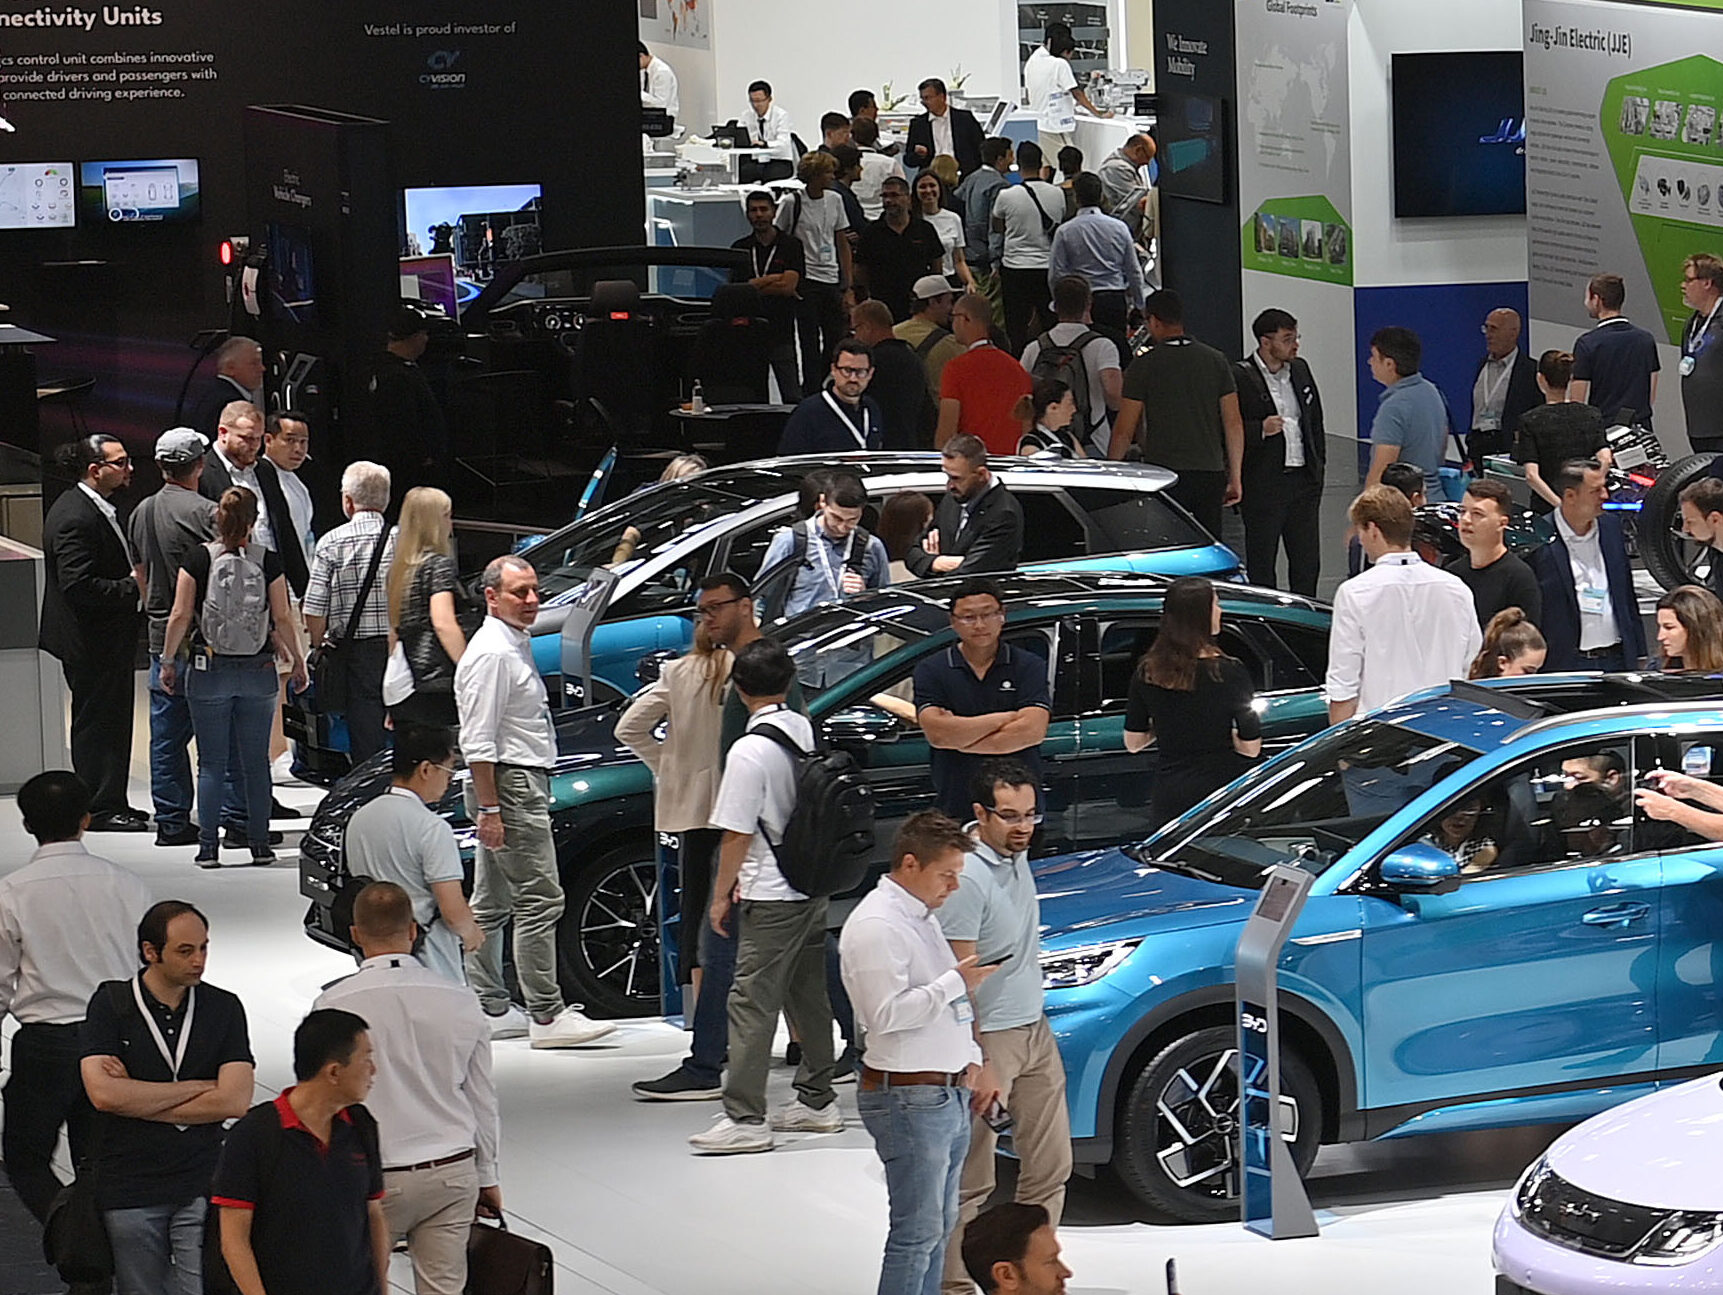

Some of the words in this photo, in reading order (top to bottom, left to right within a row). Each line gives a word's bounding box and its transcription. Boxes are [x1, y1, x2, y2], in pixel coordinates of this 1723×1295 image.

[102, 6, 163, 26] Units
[1266, 0, 1285, 13] Global
[1286, 1, 1318, 19] Footprints
[364, 24, 400, 36] Vestel
[403, 24, 413, 35] is
[415, 24, 451, 37] proud
[453, 23, 501, 35] investor
[503, 21, 517, 34] of
[1530, 22, 1568, 50] Jing-Jin
[1569, 28, 1606, 52] Electric
[1607, 31, 1632, 60] (JJE)
[17, 52, 60, 65] control
[62, 52, 87, 65] unit
[90, 51, 147, 65] combines
[150, 50, 214, 64] innovative
[47, 70, 89, 82] drivers
[92, 69, 116, 82] and
[119, 70, 188, 84] passengers
[191, 67, 218, 81] with
[2, 87, 66, 101] connected
[68, 86, 112, 102] driving
[114, 86, 186, 101] experience.
[658, 831, 679, 850] BYD
[1241, 1012, 1267, 1034] BYD
